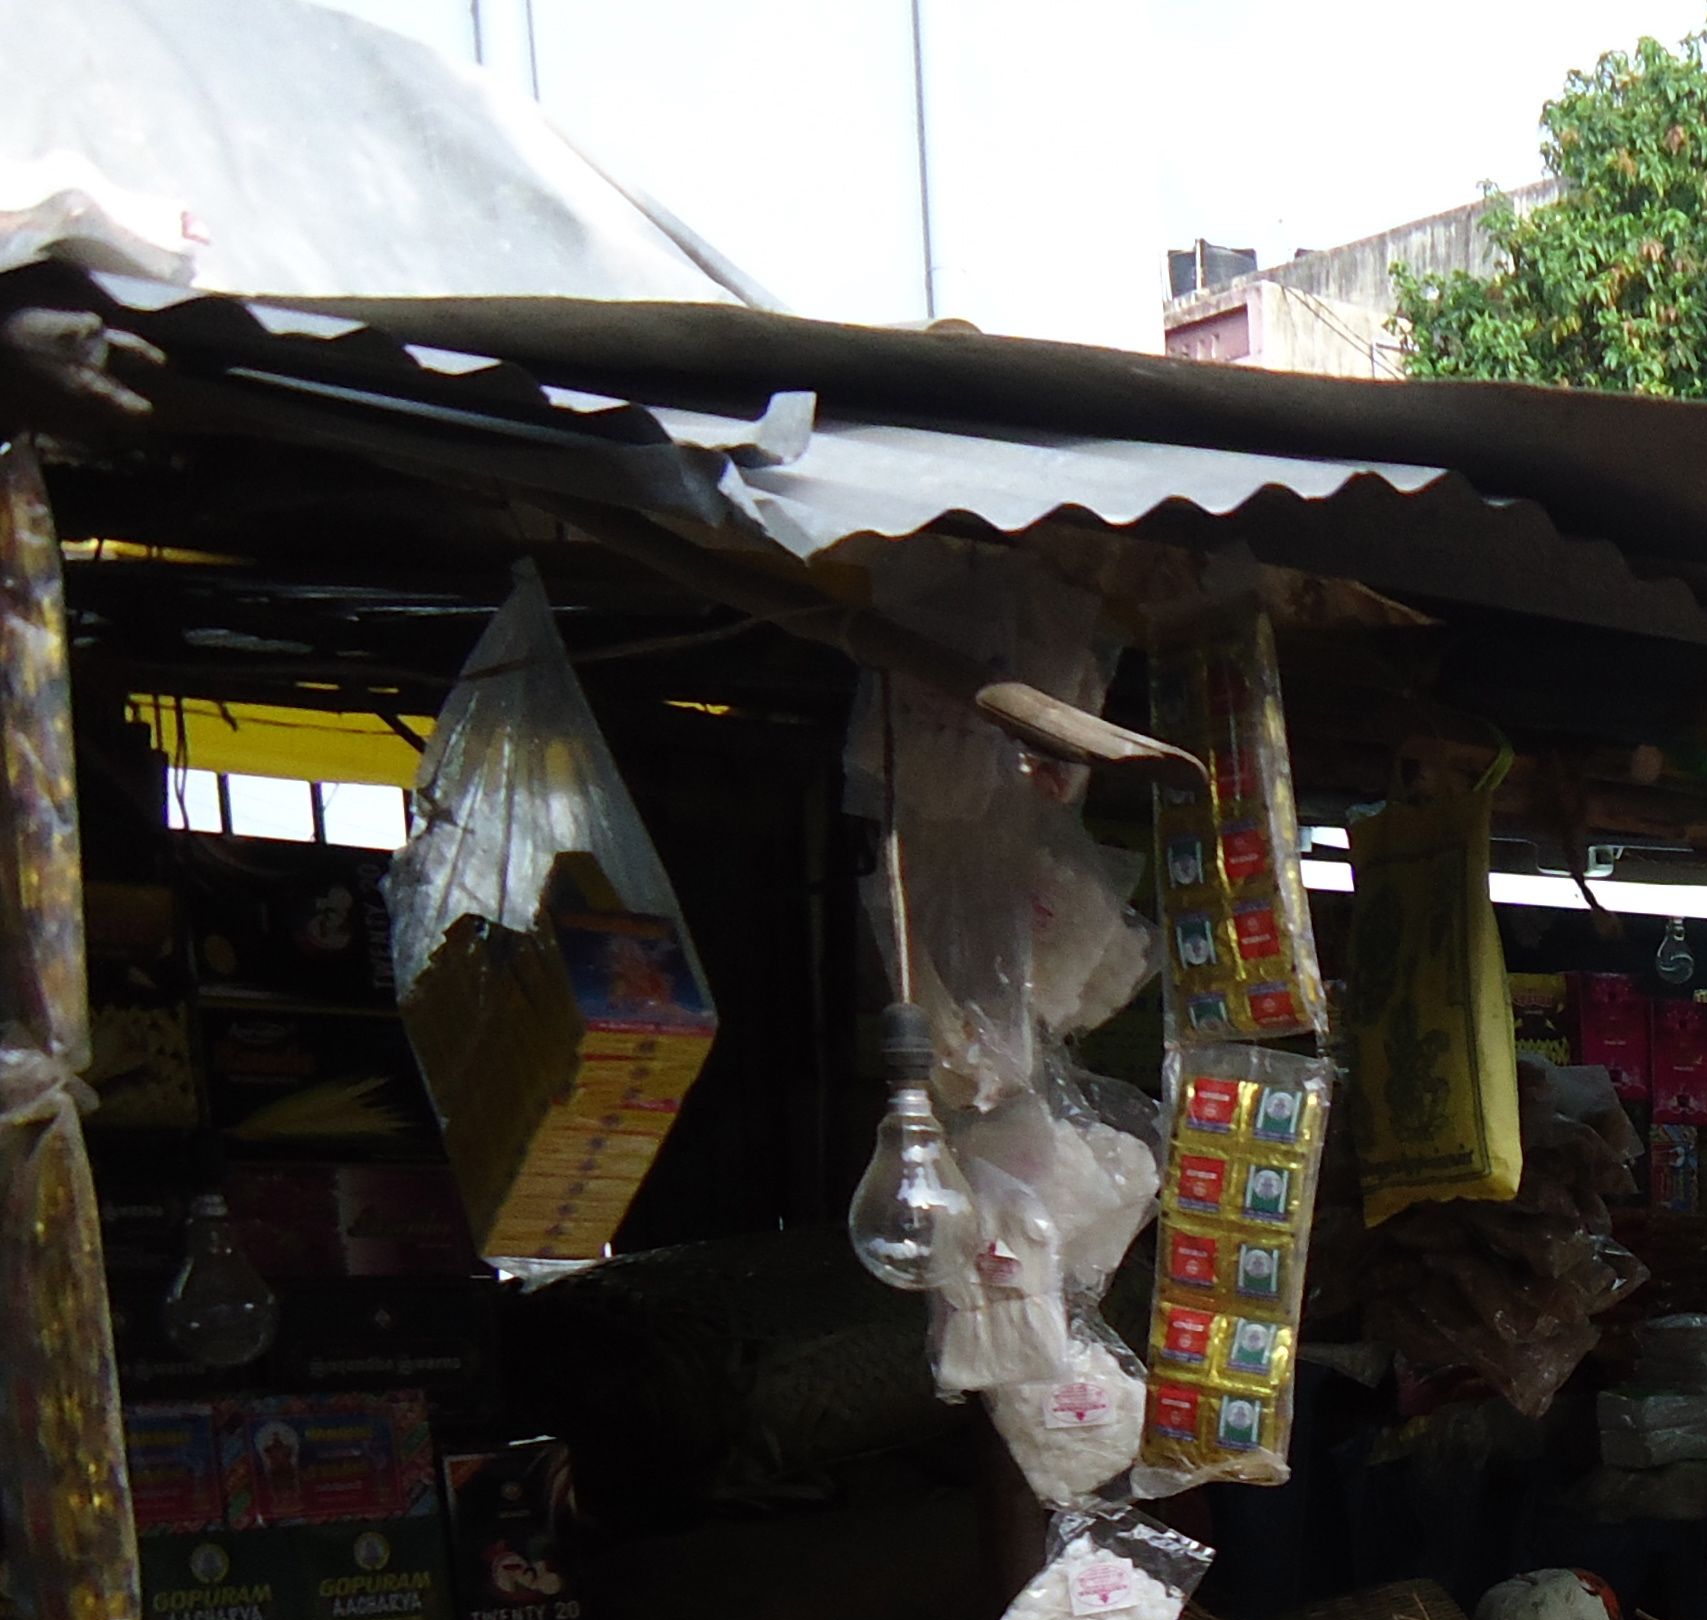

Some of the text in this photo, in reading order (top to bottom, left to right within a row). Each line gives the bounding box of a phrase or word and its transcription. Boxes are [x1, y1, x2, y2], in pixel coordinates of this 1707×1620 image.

[153, 1583, 272, 1611] GOPURAM
[320, 1570, 432, 1598] GOPURAM
[333, 1592, 422, 1618] AACHARYA
[555, 1600, 581, 1620] 20
